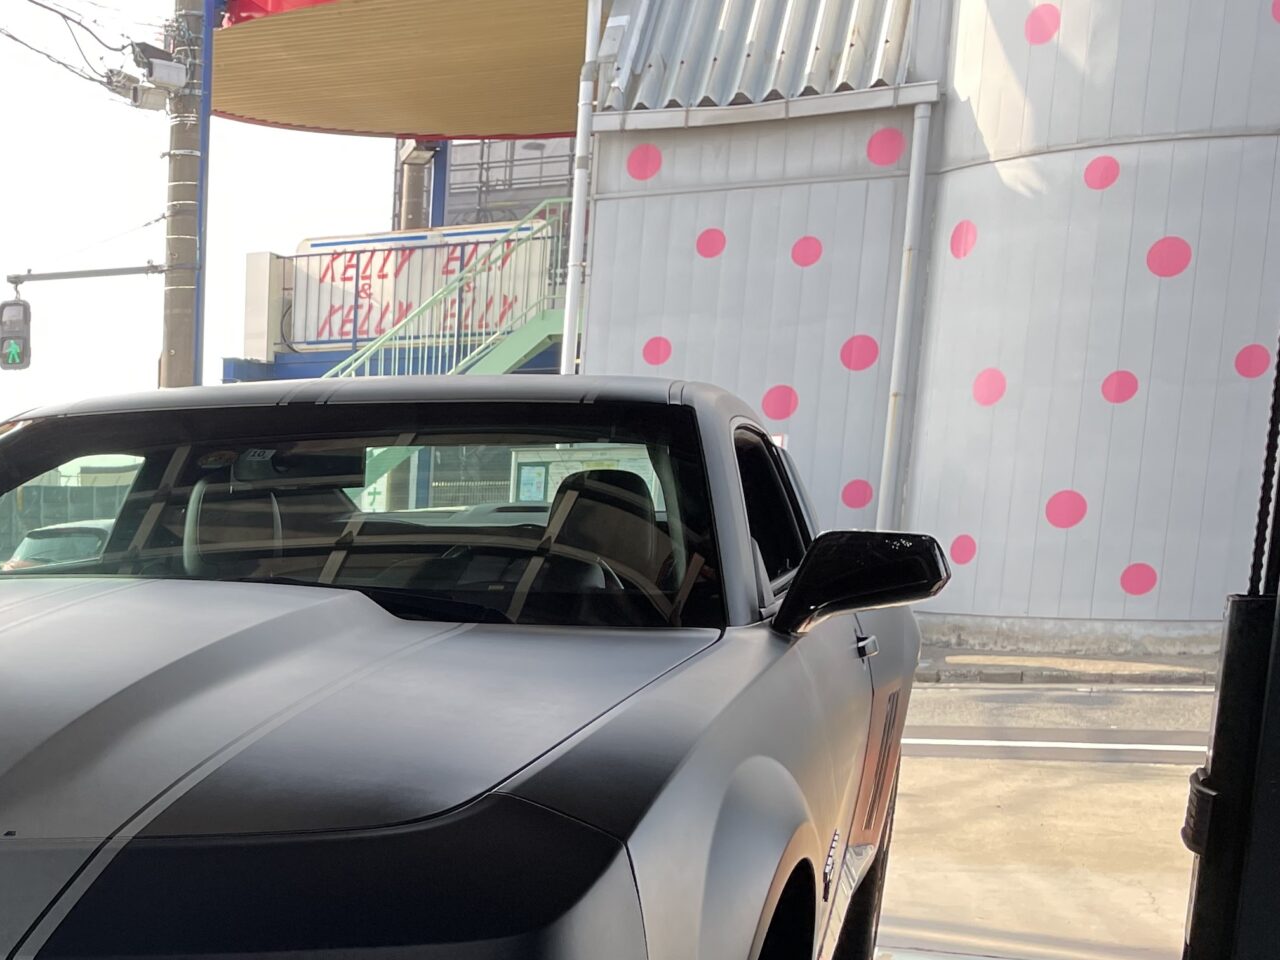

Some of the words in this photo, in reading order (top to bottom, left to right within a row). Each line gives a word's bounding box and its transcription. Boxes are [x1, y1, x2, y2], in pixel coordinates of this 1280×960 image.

[320, 246, 416, 284] KELLY
[357, 283, 373, 299] &
[317, 301, 413, 338] KELLY
